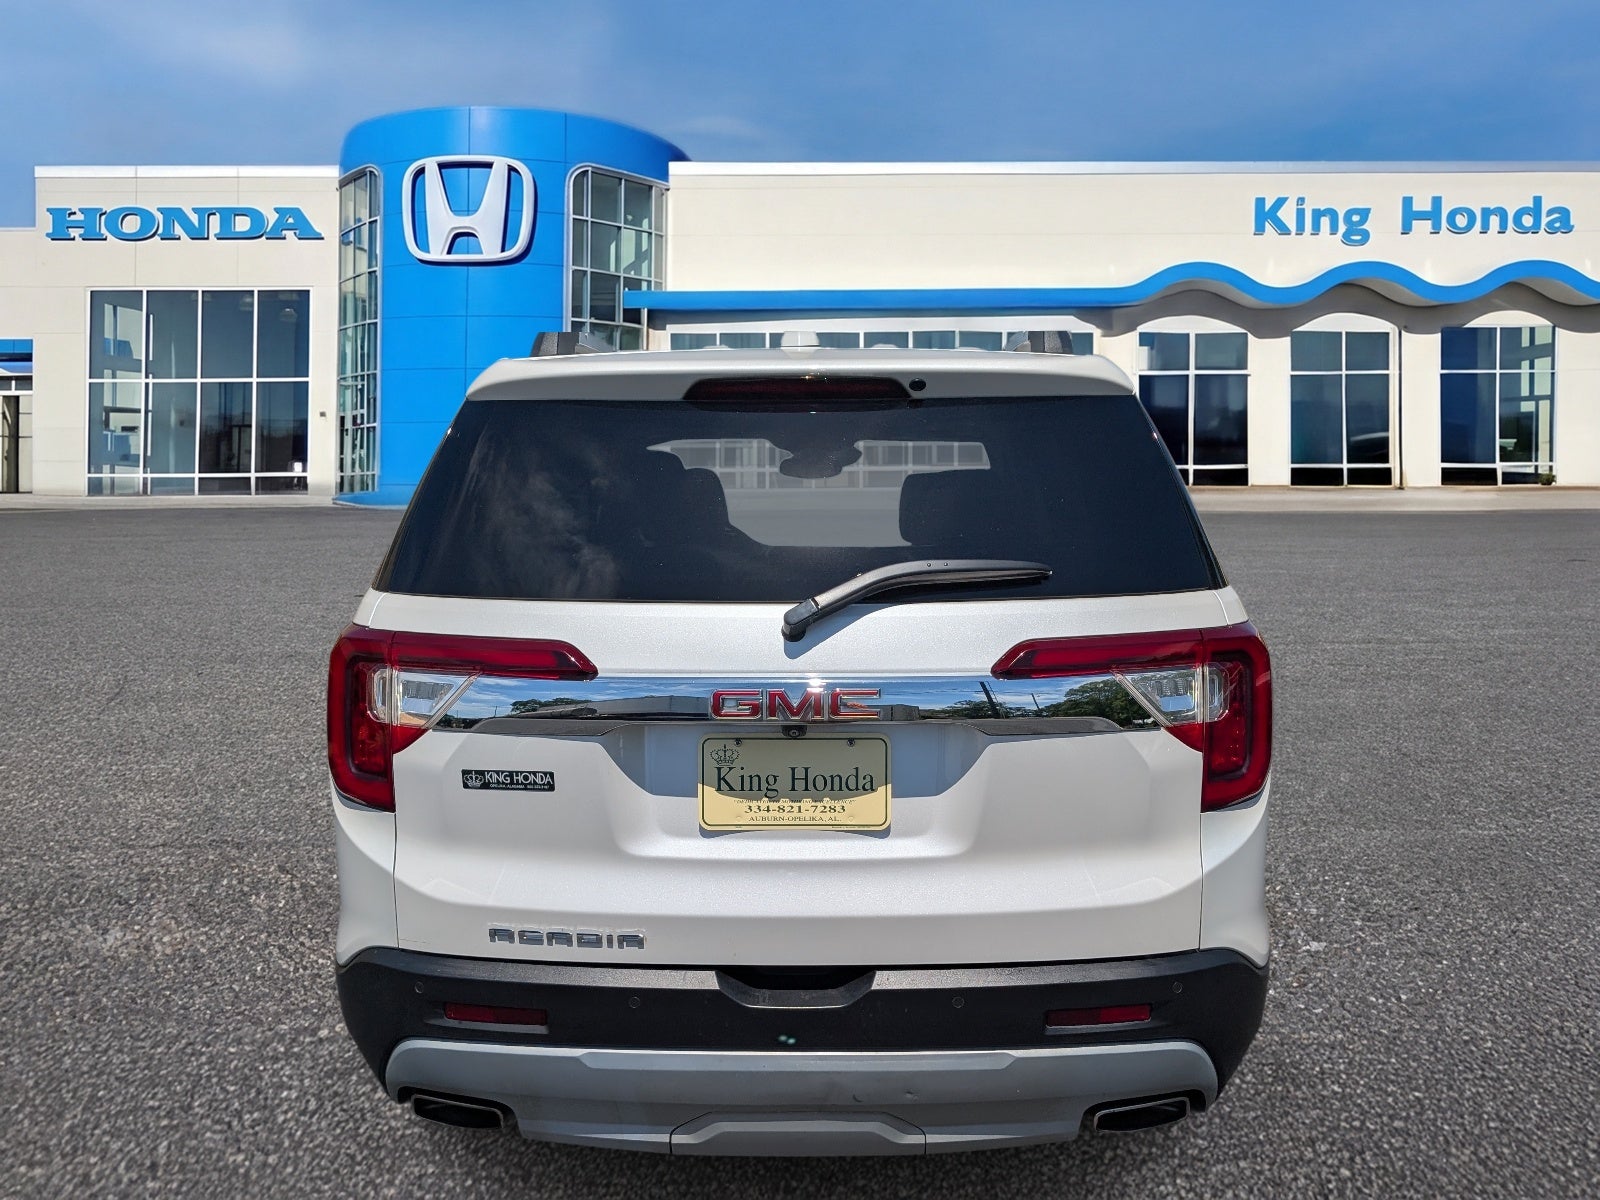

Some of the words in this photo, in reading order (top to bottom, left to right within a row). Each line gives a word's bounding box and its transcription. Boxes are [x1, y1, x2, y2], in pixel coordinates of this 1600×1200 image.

[46, 206, 324, 241] HONDA
[1254, 196, 1372, 246] King
[1400, 195, 1575, 235] Honda
[710, 688, 881, 720] GMC
[484, 771, 511, 783] KING
[513, 772, 553, 784] HONDA
[714, 766, 780, 799] King
[788, 766, 876, 792] Honda
[744, 804, 846, 814] 334-821-7283
[488, 924, 646, 950] ACADIA
